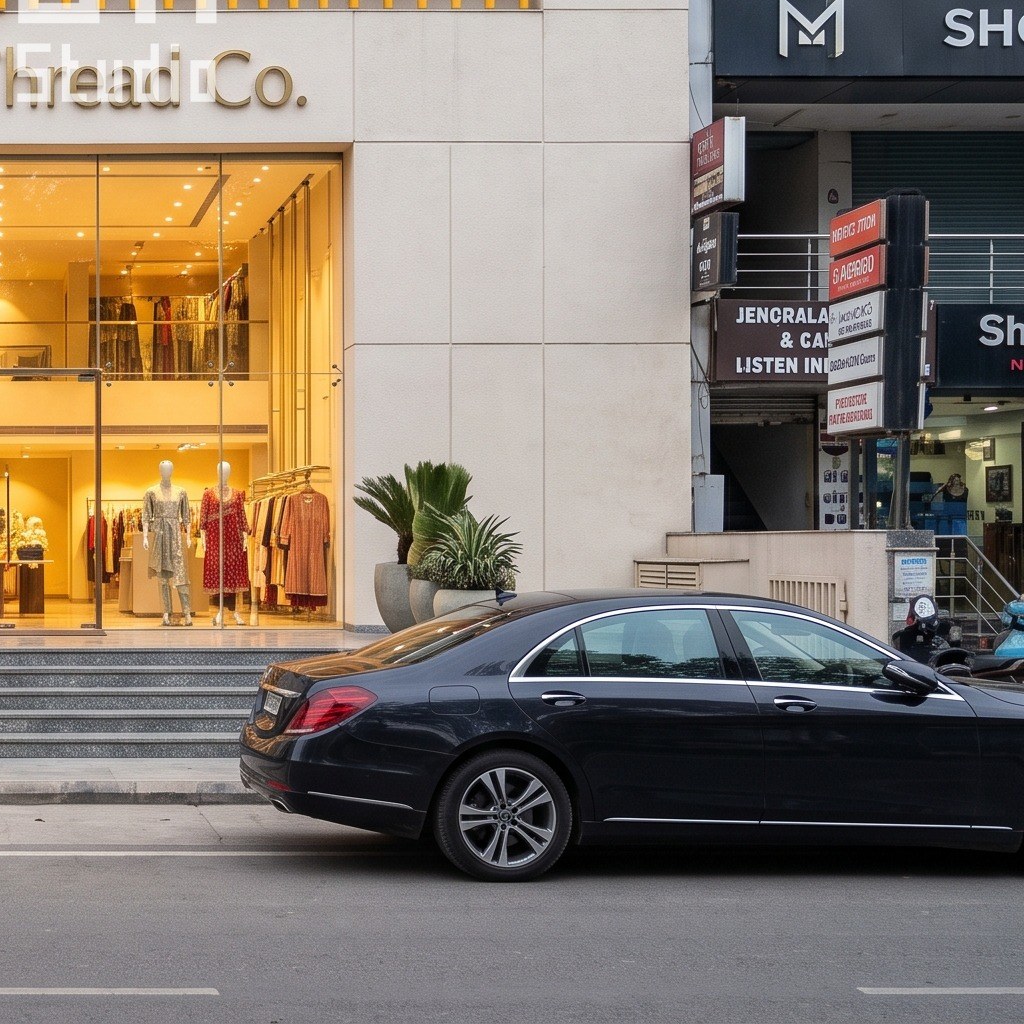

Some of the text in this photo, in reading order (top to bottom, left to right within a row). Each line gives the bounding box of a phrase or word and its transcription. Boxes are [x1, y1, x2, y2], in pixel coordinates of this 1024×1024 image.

[943, 8, 1024, 47] SH
[210, 49, 308, 109] Co.
[780, 331, 794, 349] &
